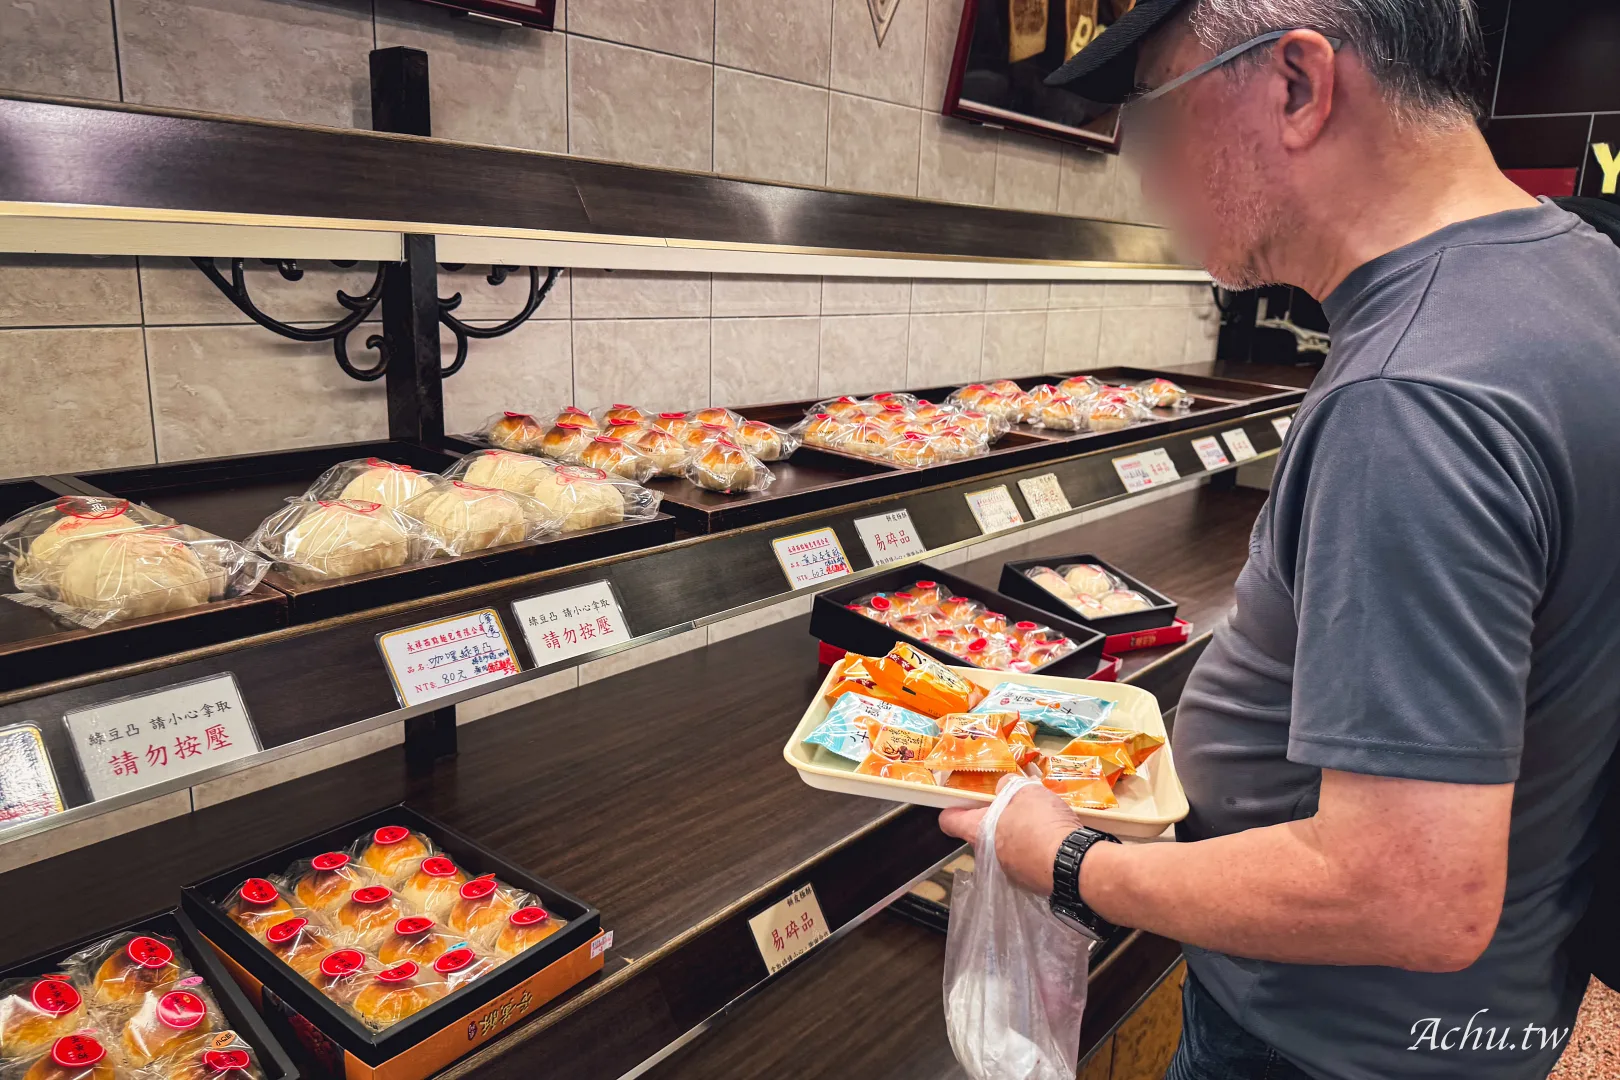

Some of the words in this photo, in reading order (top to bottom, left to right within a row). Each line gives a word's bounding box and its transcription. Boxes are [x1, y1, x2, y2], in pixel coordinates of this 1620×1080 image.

[874, 530, 910, 551] 易碎品
[528, 611, 558, 627] 綠豆凸
[562, 599, 610, 618] 請小心拿取
[542, 615, 614, 650] 請勿按壓
[442, 669, 467, 684] 80元
[88, 723, 140, 747] 綠豆凸
[149, 700, 232, 730] 請小心拿取
[108, 723, 233, 777] 請勿按壓
[771, 911, 814, 952] 易碎品
